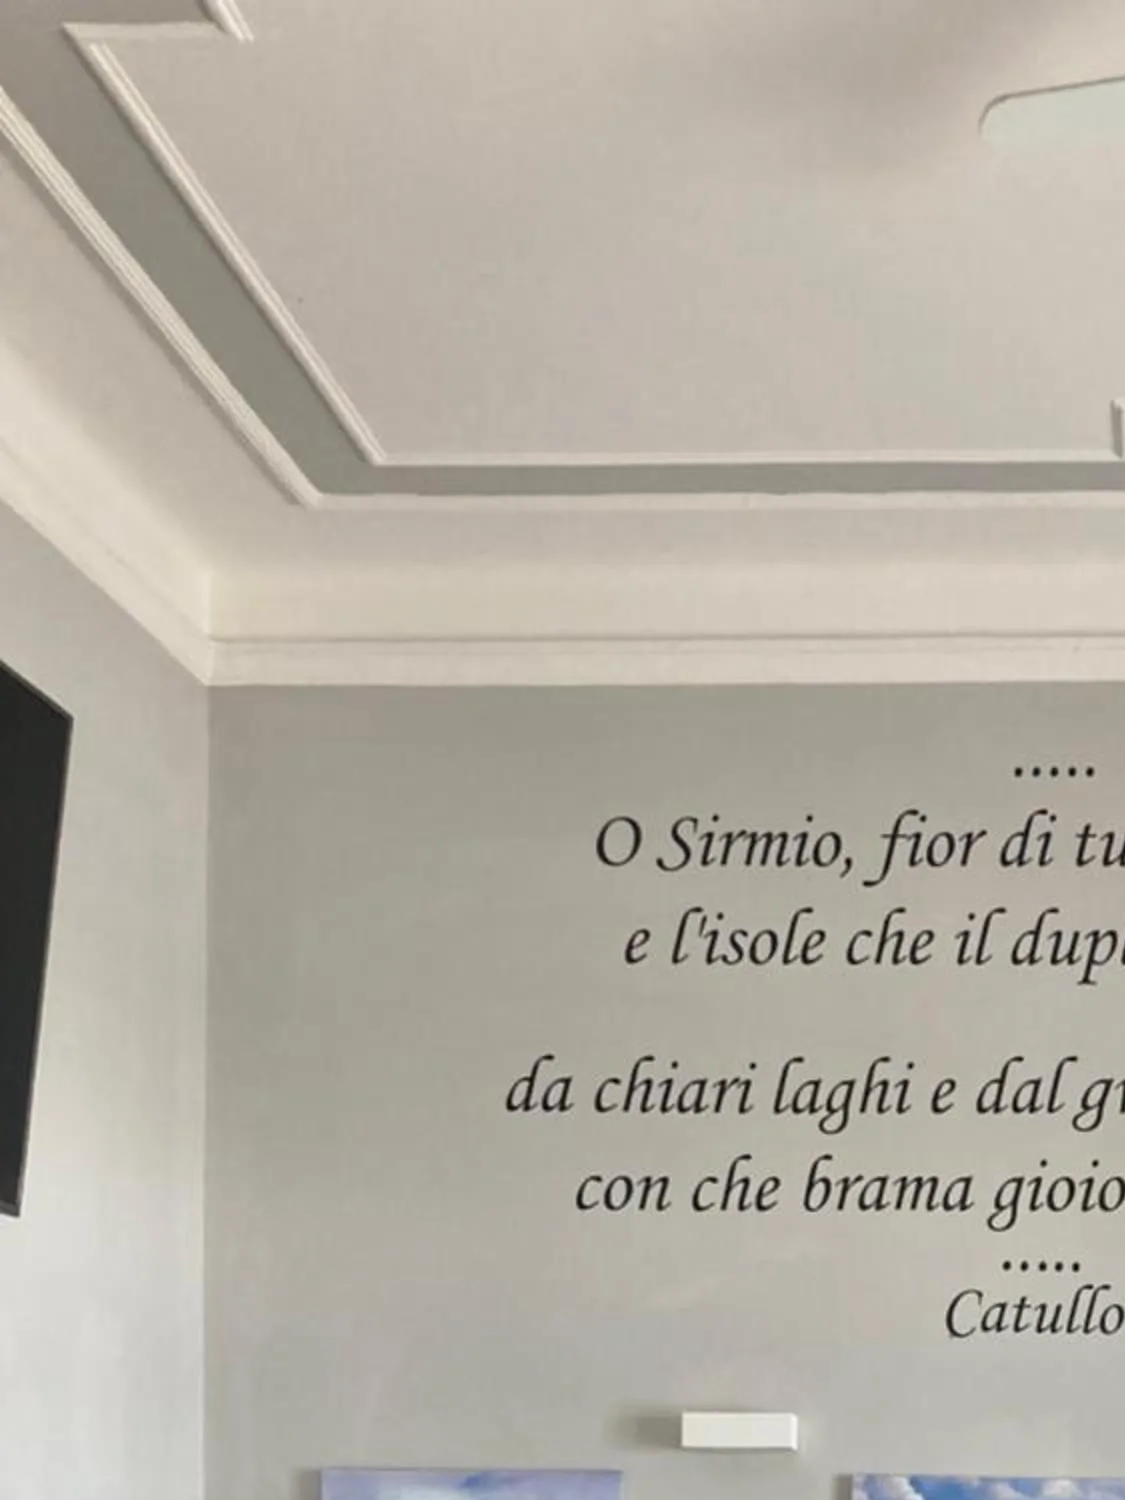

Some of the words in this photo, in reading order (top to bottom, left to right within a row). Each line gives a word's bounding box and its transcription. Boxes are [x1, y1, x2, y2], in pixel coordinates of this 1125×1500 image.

[595, 816, 643, 867] O
[655, 813, 853, 879] Sirmio,
[861, 808, 988, 888] fior
[999, 808, 1057, 868] di
[624, 928, 652, 965] e
[671, 906, 827, 966] l'isole
[845, 906, 936, 966] che
[954, 906, 1008, 967] il
[505, 1053, 574, 1113] da
[593, 1054, 757, 1115] chiari
[772, 1055, 915, 1136] laghi
[930, 1077, 957, 1115] e
[975, 1055, 1079, 1115] dal
[575, 1174, 672, 1212] con
[691, 1153, 782, 1213] che
[802, 1153, 975, 1213] brama
[945, 1283, 1125, 1339] Catullo
